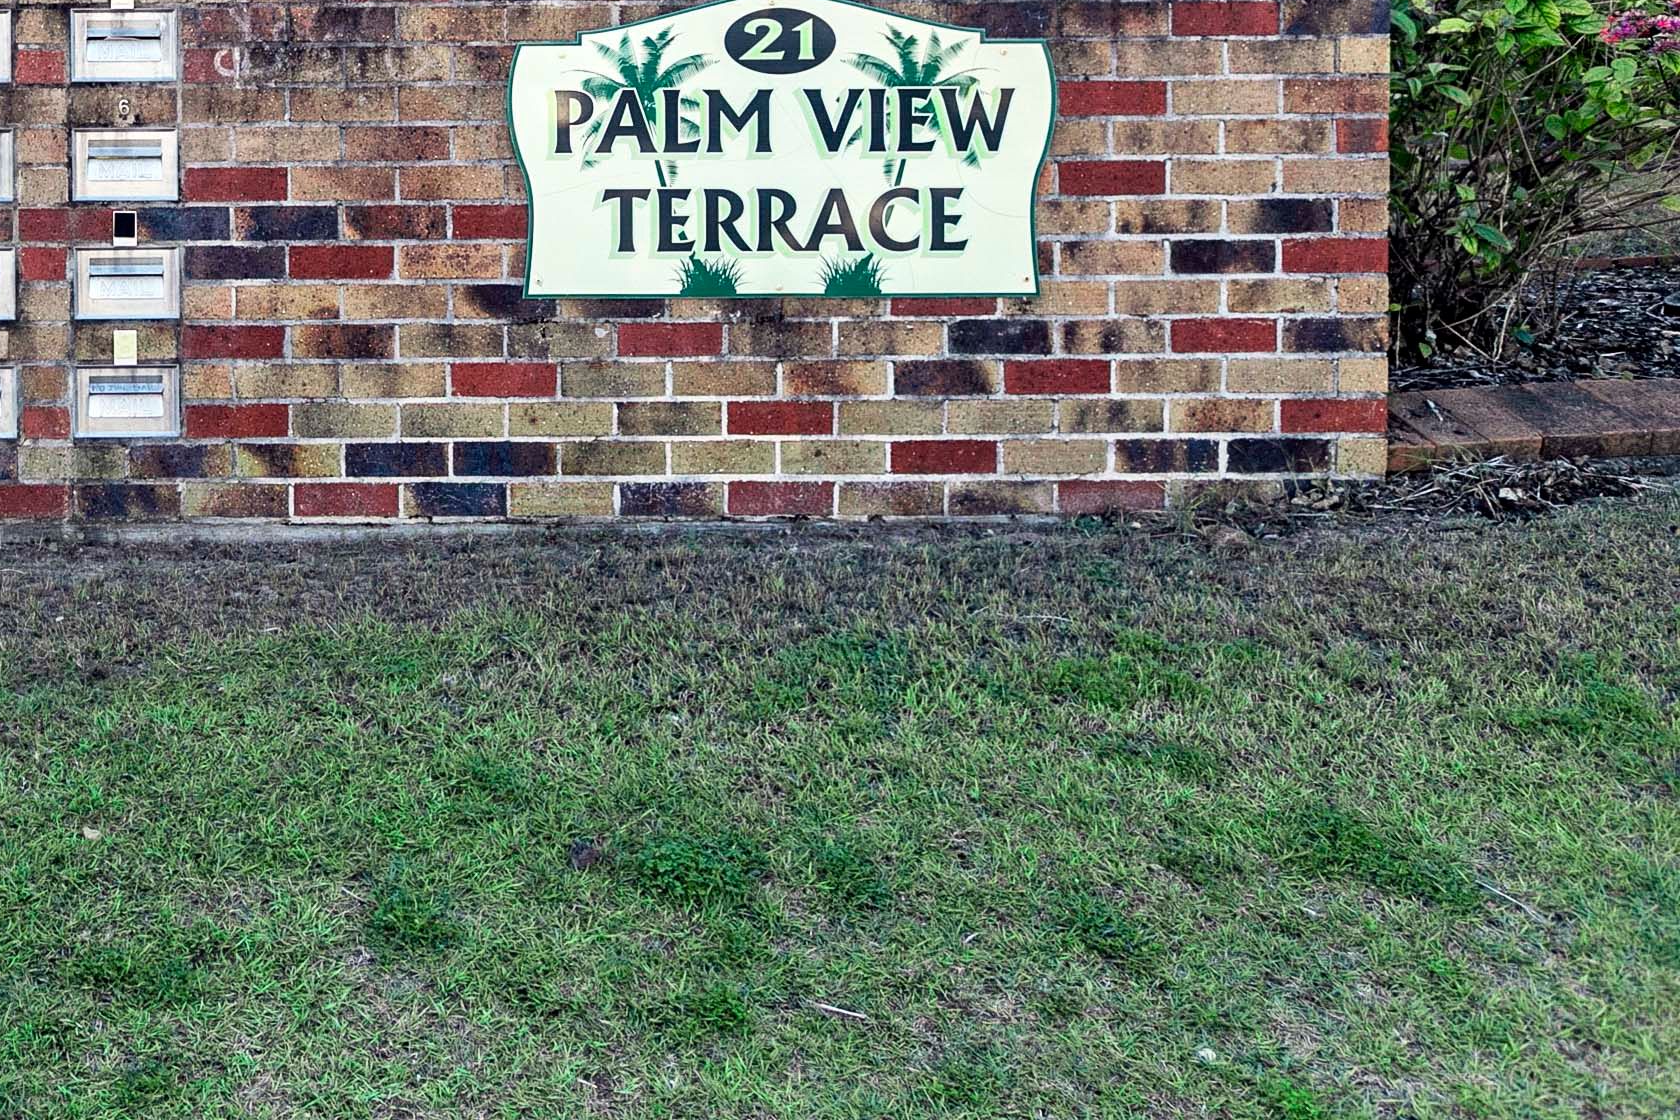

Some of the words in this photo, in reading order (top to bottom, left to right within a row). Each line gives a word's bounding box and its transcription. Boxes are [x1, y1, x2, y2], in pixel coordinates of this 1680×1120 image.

[738, 17, 816, 62] 21
[117, 99, 130, 116] 6
[553, 88, 774, 154] PALM
[803, 87, 1015, 154] VIEW
[99, 161, 152, 179] MAIL
[601, 186, 970, 253] TERRACE
[100, 279, 154, 297] MAIL
[100, 397, 153, 415] MAIL
